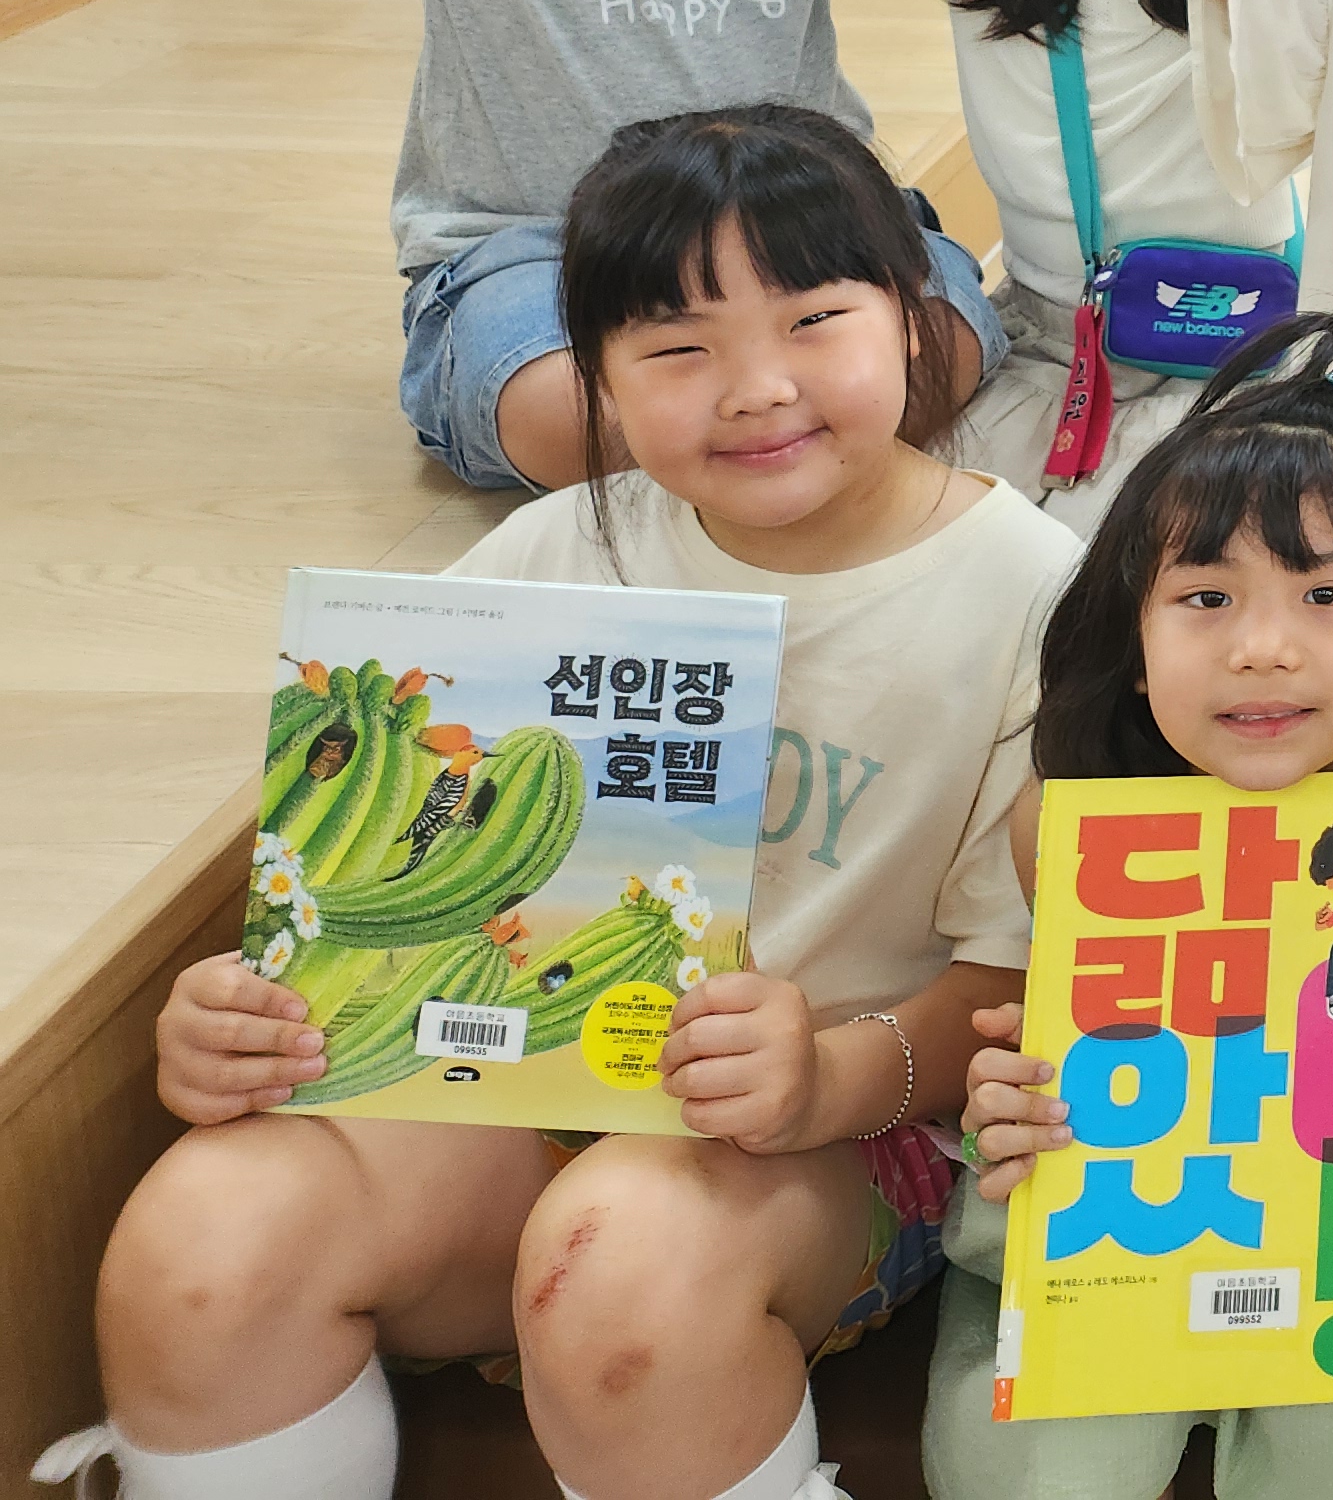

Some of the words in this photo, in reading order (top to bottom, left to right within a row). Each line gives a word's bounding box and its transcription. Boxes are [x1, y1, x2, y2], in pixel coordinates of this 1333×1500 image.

[1154, 320, 1182, 333] new
[1186, 321, 1245, 338] balance
[543, 653, 734, 729] 선인장
[596, 733, 724, 805] 호텔
[454, 1045, 487, 1056] 099535
[1228, 1314, 1262, 1325] 099552
